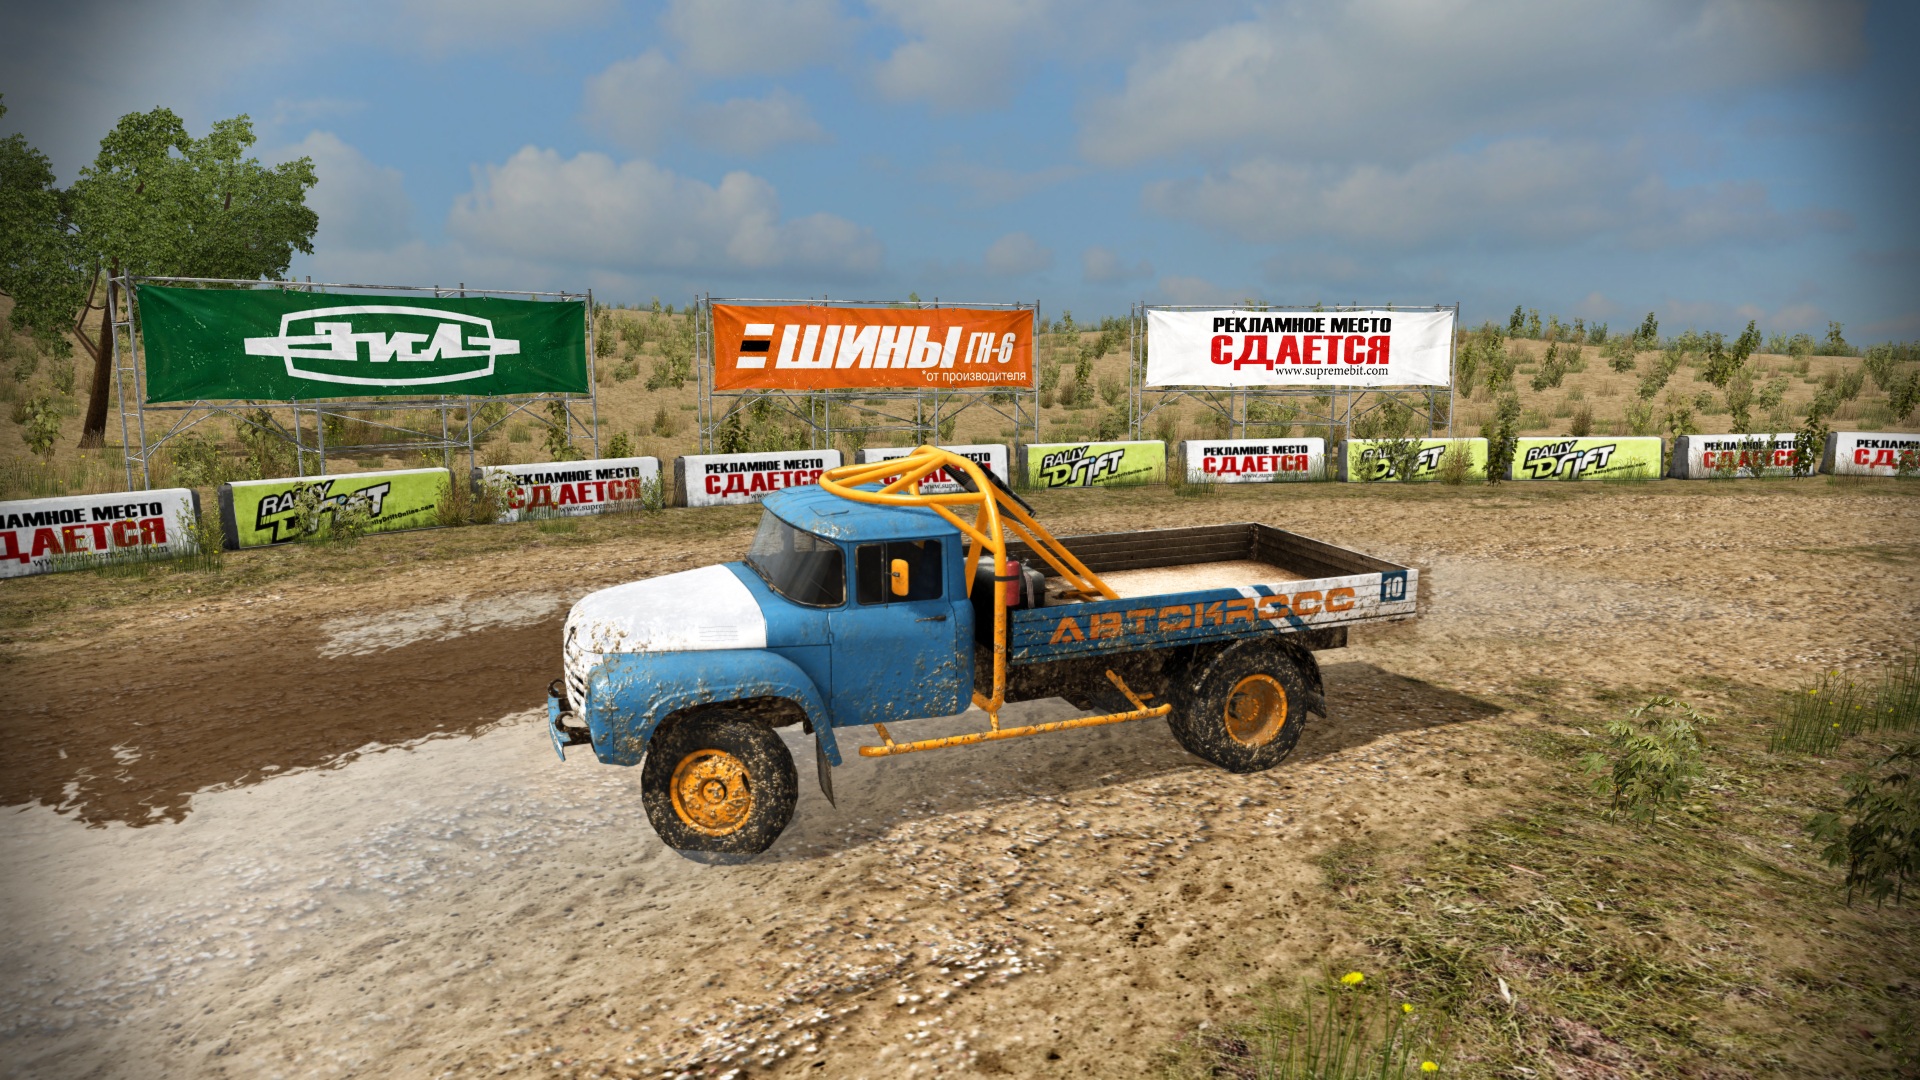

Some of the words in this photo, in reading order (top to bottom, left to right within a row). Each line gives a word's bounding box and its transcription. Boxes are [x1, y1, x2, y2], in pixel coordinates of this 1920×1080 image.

[1213, 317, 1325, 333] РЕКЛАМНОЕ
[1330, 317, 1392, 333] МЕСТО
[774, 324, 963, 369] ШИНЫ
[964, 332, 1016, 363] ГН-6
[1210, 334, 1390, 370] СДАЕТСЯ
[942, 371, 1026, 383] производителя
[1275, 364, 1389, 380] www.supremebit.com
[959, 452, 991, 463] ЕСТО
[1042, 445, 1089, 469] RALLY
[1203, 446, 1270, 456] РЕКЛАМНОЕ
[1272, 445, 1308, 454] МЕСТО
[1525, 440, 1578, 461] RALLY
[595, 466, 640, 481] МЕСТО
[705, 460, 781, 474] РЕКЛАМНОЕ
[784, 458, 823, 470] МЕСТО
[1203, 454, 1308, 477] СДАЕТСЯ
[91, 502, 164, 521] МЕСТО
[1382, 575, 1403, 599] 10
[1049, 586, 1356, 645] АВТОКРОСС
